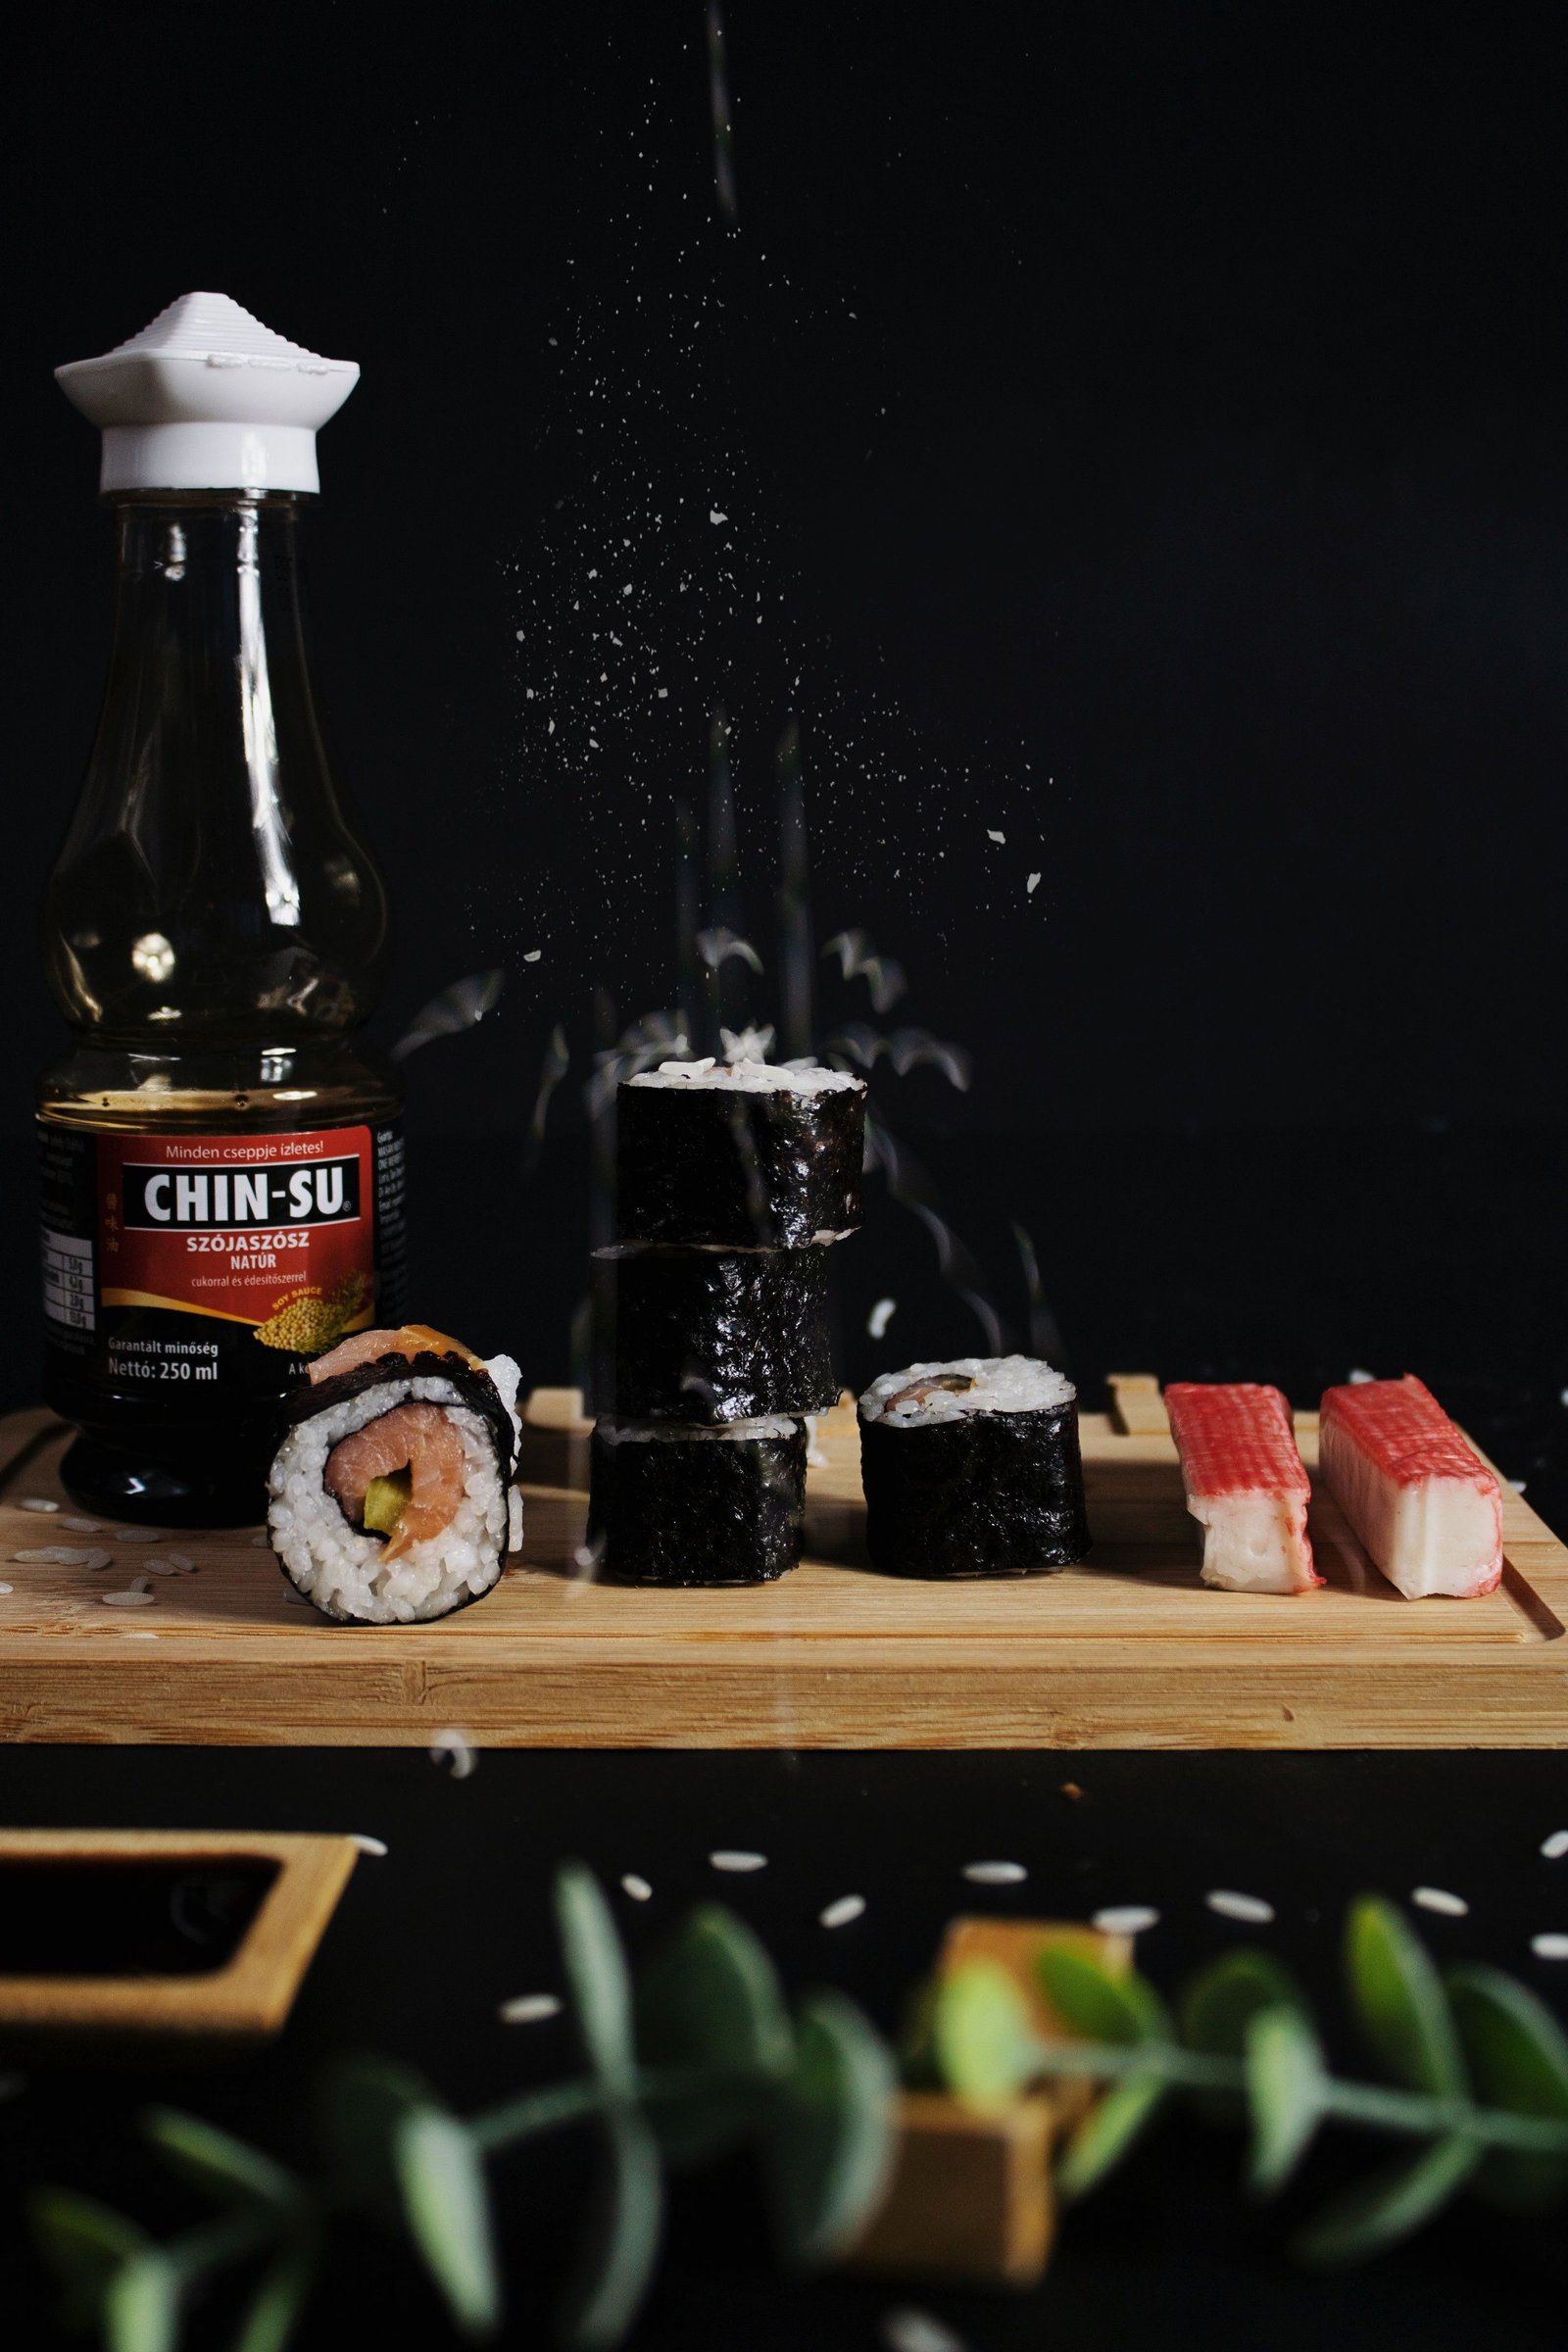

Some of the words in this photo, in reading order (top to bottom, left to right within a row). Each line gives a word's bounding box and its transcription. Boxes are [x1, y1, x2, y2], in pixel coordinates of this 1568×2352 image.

[166, 1145, 220, 1159] Minden
[223, 1146, 277, 1160] cseppje
[280, 1140, 324, 1156] ízletes!
[186, 1231, 310, 1252] SZÓJASZÓSZ
[230, 1251, 276, 1270] NATÚR
[191, 1275, 229, 1287] cukorral
[231, 1276, 242, 1287] és
[271, 1294, 289, 1310] SOY
[291, 1287, 322, 1298] SAUCE
[108, 1337, 162, 1353] Garantált
[165, 1341, 219, 1358] minőség
[109, 1356, 156, 1378] Nettó:
[160, 1361, 191, 1380] 250
[195, 1361, 218, 1380] ml
